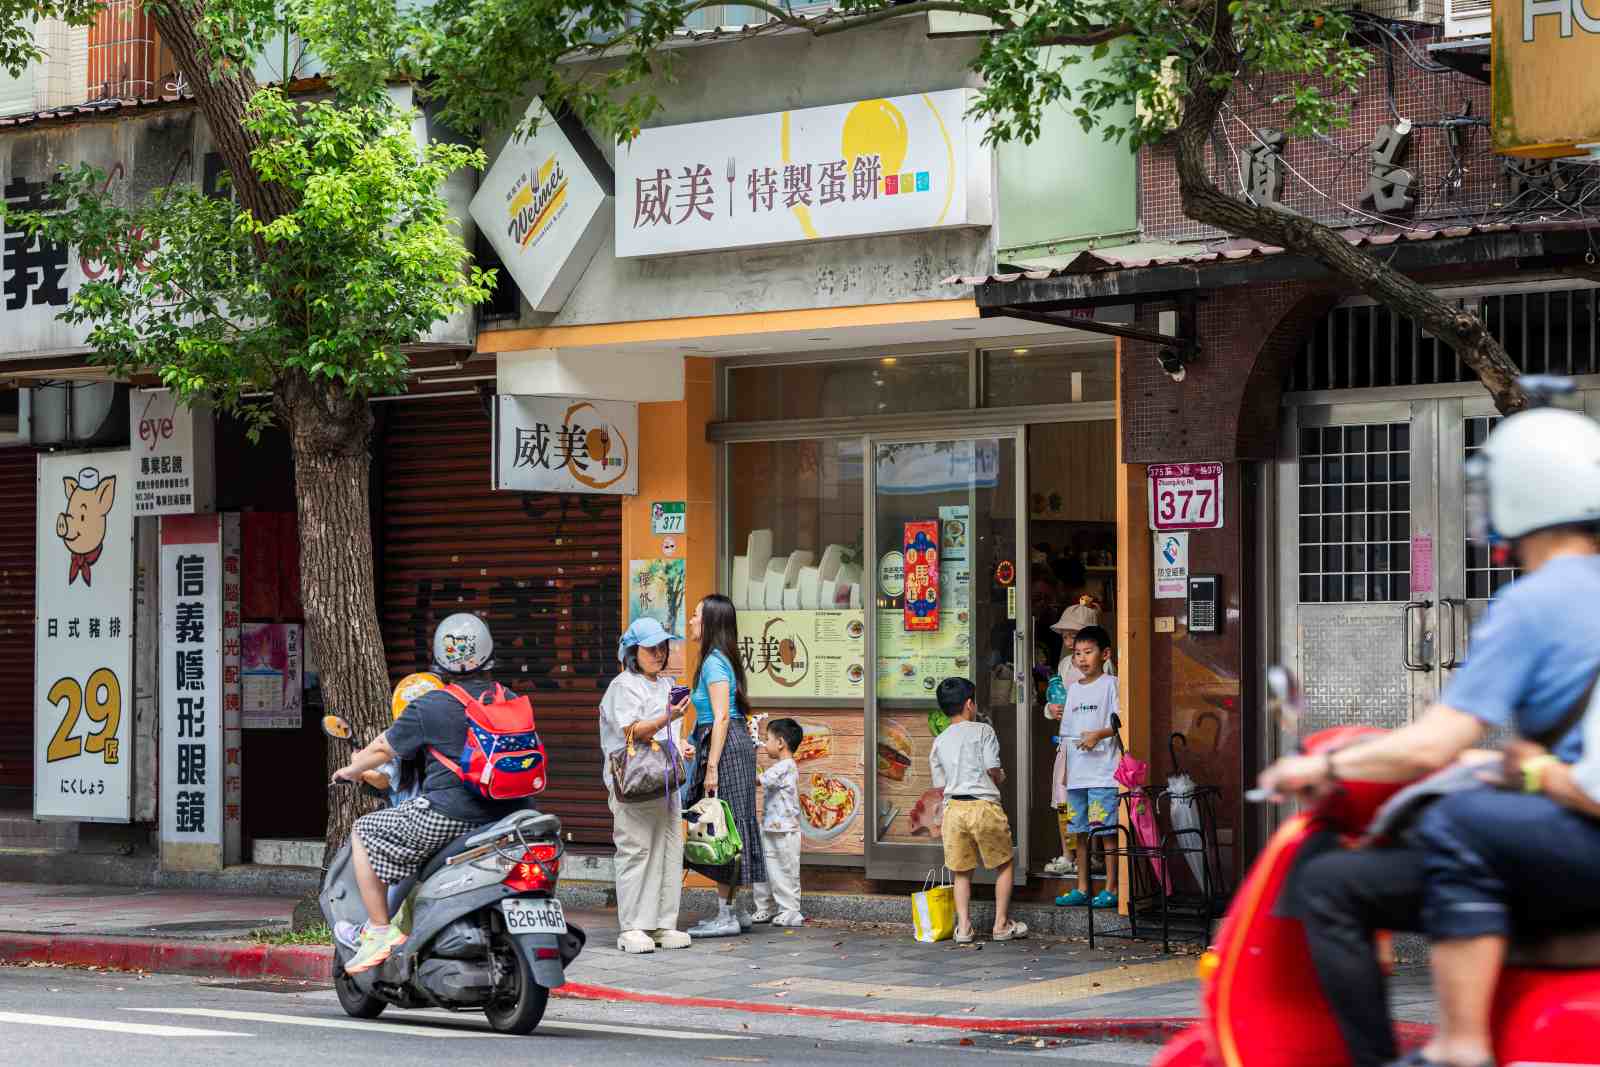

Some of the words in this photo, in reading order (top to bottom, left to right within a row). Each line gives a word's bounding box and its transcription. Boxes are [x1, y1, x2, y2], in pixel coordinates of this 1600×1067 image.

[508, 161, 563, 244] Weimei
[633, 164, 714, 229] 威美
[747, 155, 883, 213] 特製蛋餅
[139, 411, 175, 451] eye
[513, 423, 589, 471] 威美
[662, 515, 682, 531] 377
[1160, 489, 1212, 521] 377
[48, 616, 121, 639] 日式豬排
[47, 667, 122, 763] 29
[176, 554, 206, 833] 信義隱形眼鏡
[60, 779, 105, 795] にくしょう
